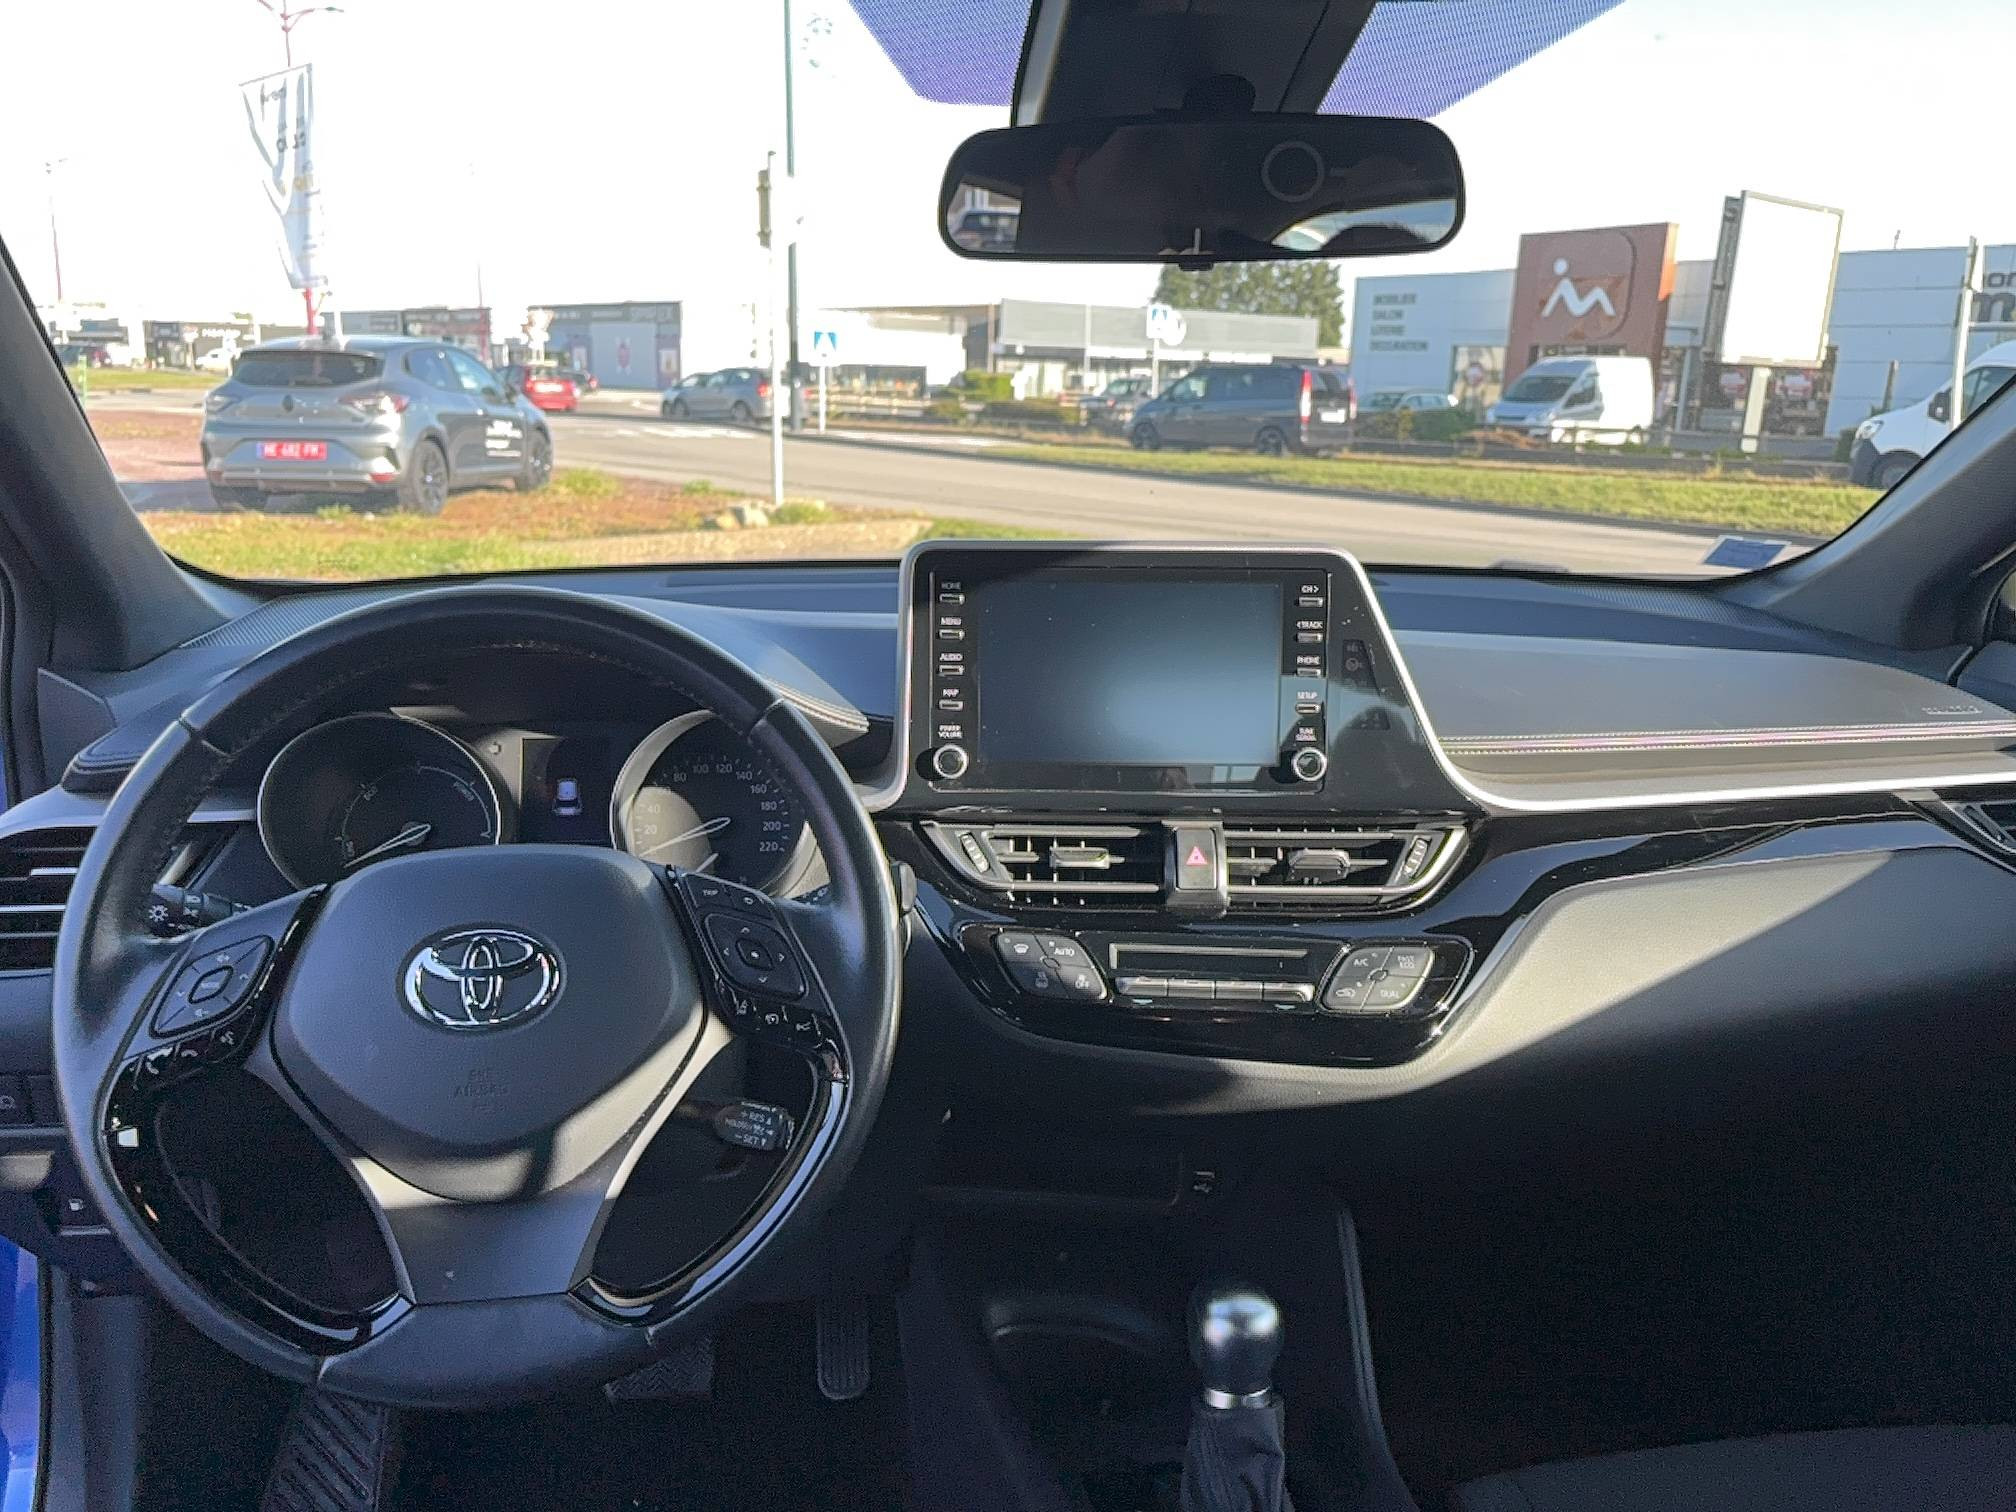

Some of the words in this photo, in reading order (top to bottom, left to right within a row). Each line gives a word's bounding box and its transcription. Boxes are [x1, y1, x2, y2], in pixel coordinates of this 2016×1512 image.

[941, 617, 961, 626] MENU
[940, 653, 963, 661] AUDIO
[1297, 656, 1320, 665] PHONE
[943, 688, 960, 697] MAP
[1297, 691, 1318, 699] SETUP
[716, 763, 733, 773] 120
[673, 772, 688, 782] 80
[736, 770, 753, 780] 140
[750, 784, 767, 794] 160
[648, 803, 661, 814] 40
[761, 801, 777, 811] 180
[644, 824, 658, 835] 20
[762, 821, 782, 831] 200
[759, 841, 779, 852] 220
[1054, 947, 1075, 957] AUTO
[1353, 958, 1369, 967] A/C
[1380, 989, 1399, 999] DUAL
